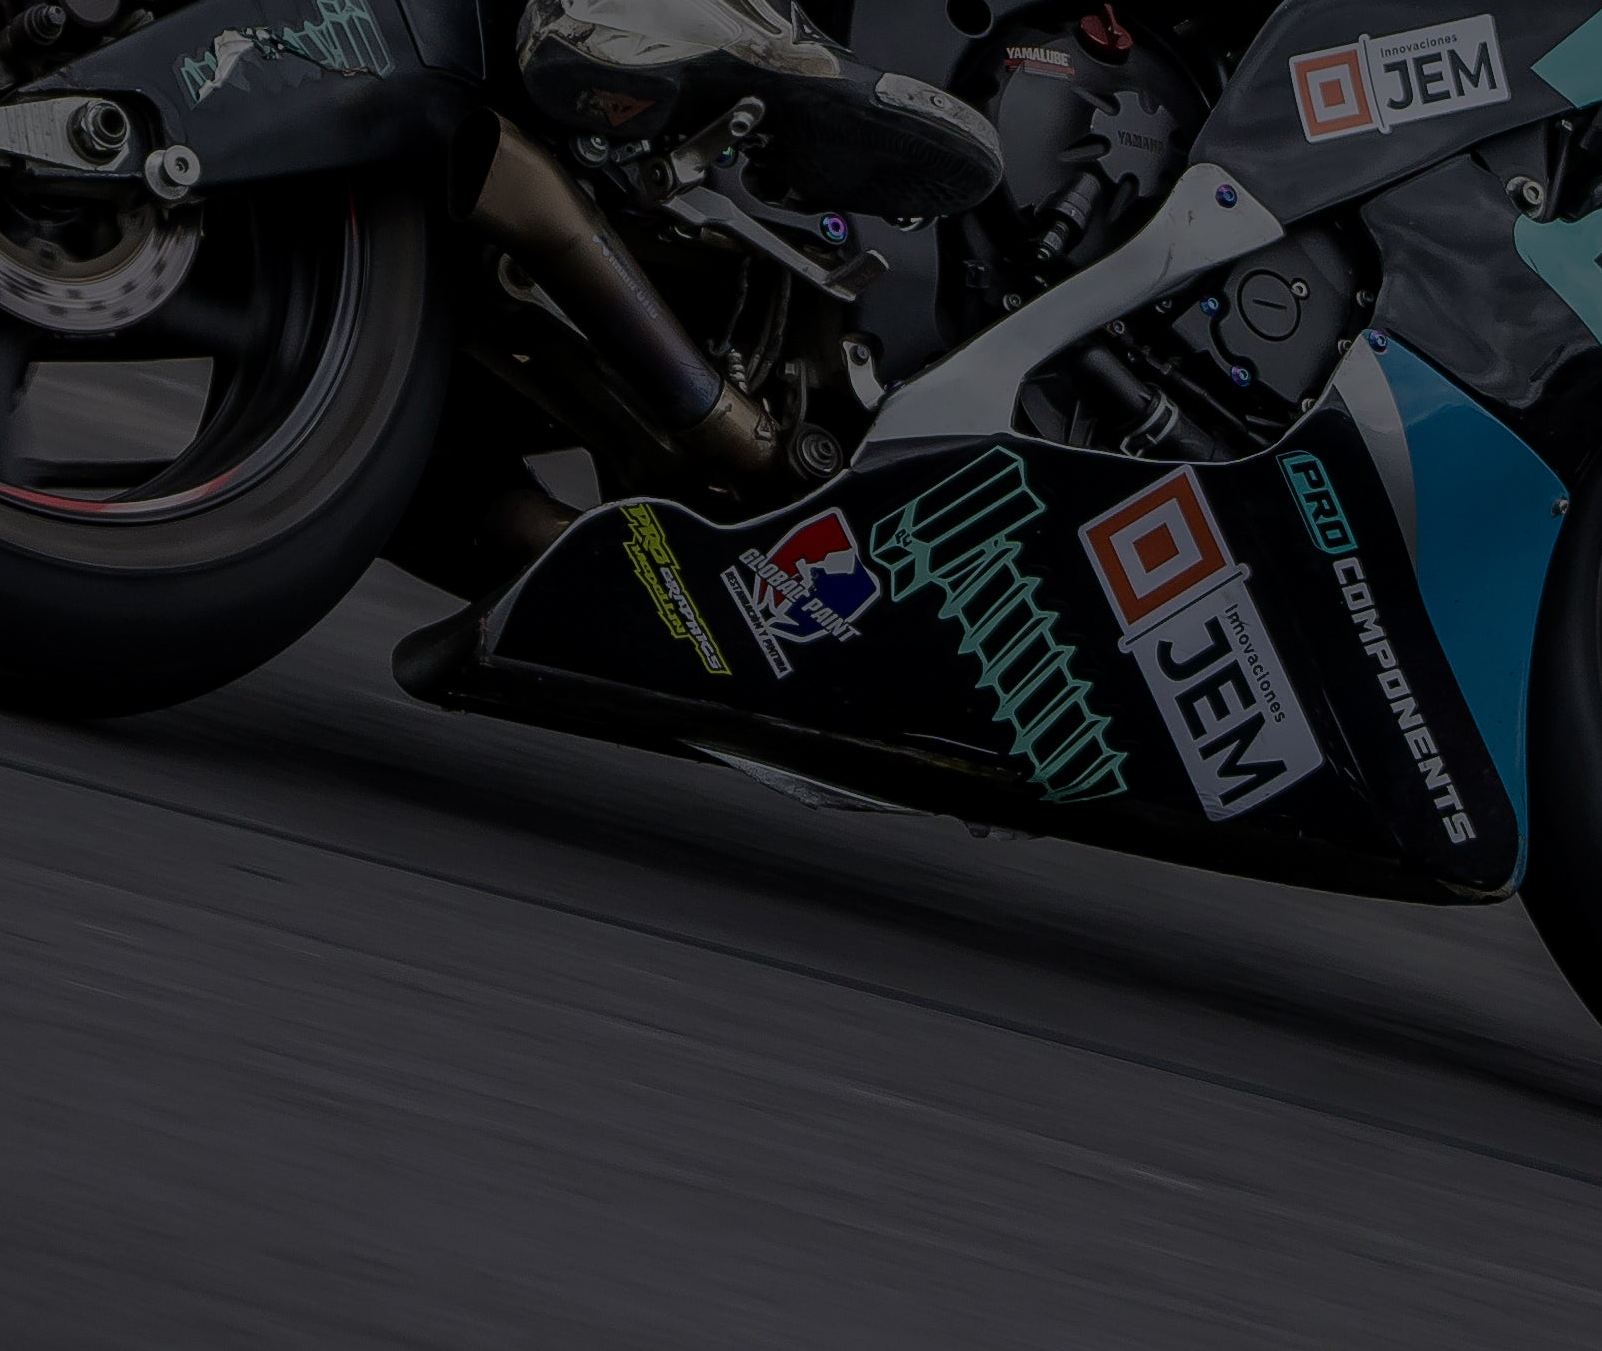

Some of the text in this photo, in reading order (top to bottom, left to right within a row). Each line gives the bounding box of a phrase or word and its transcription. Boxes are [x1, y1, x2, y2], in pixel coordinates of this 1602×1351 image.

[1006, 46, 1070, 67] YAMALUBE
[1382, 41, 1497, 110] JEM
[739, 549, 863, 642] GLOBAL PAINT
[1290, 463, 1476, 844] PRO COMPONENTS
[1156, 616, 1288, 809] JEM
